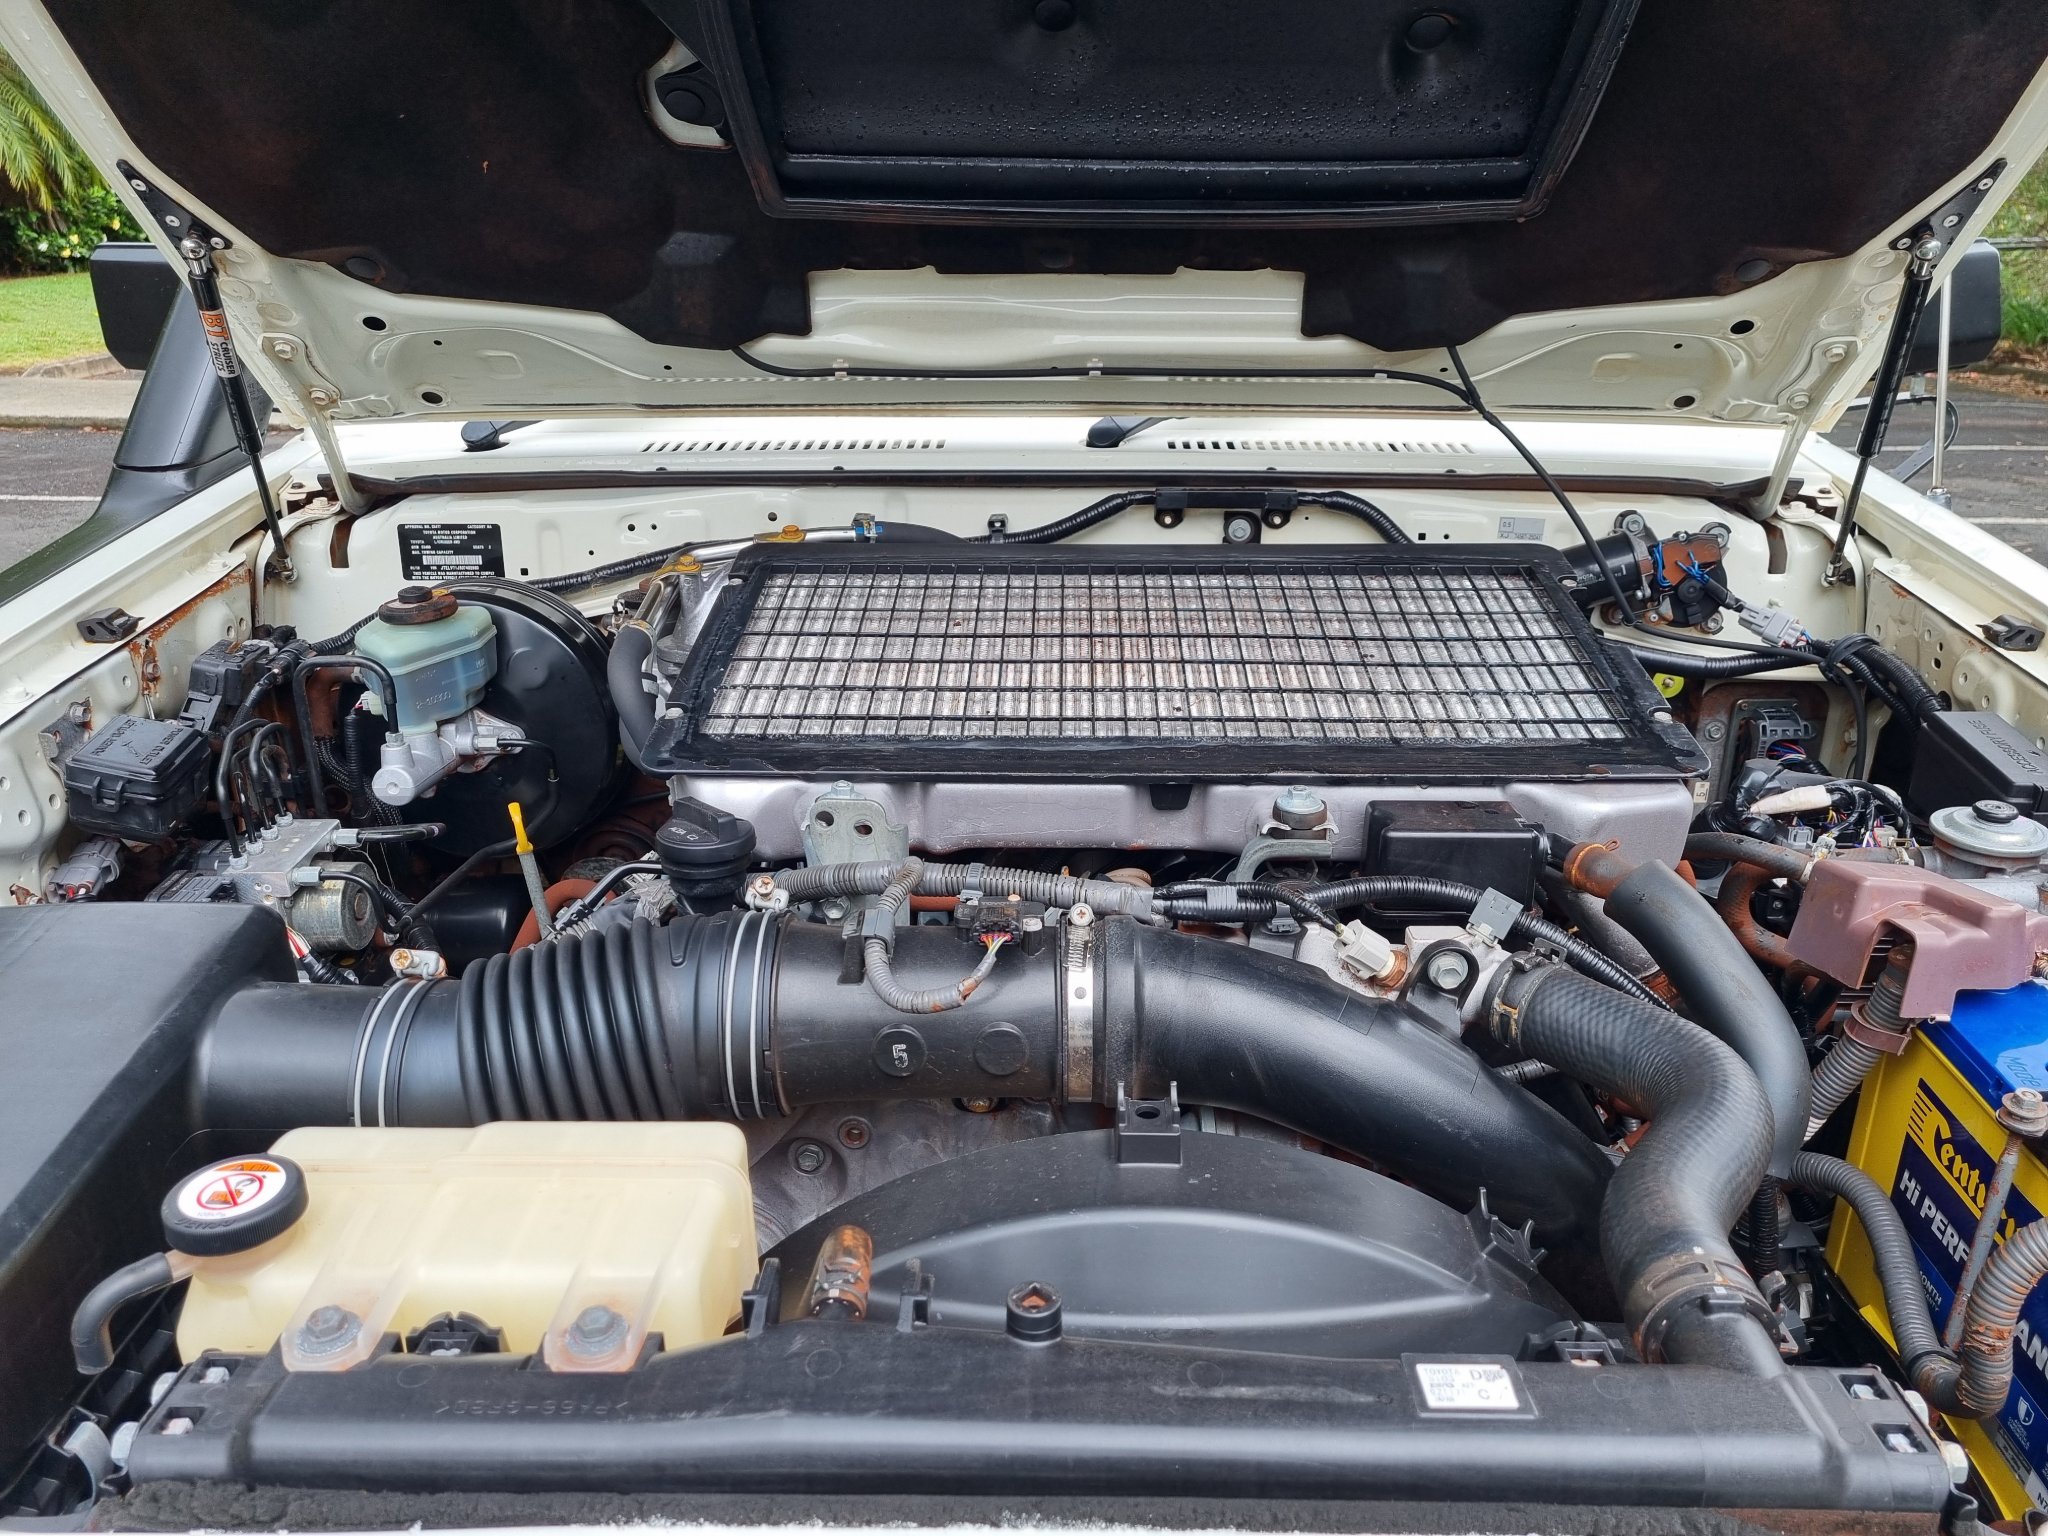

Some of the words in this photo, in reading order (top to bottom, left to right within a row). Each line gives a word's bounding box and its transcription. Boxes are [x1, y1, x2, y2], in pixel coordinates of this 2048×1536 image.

[201, 312, 229, 341] BT
[210, 341, 225, 372] STRUTS
[220, 341, 236, 375] CRUISER
[892, 1043, 909, 1068] 5
[1900, 1168, 1922, 1206] Hi
[1920, 1271, 1942, 1305] ONTH
